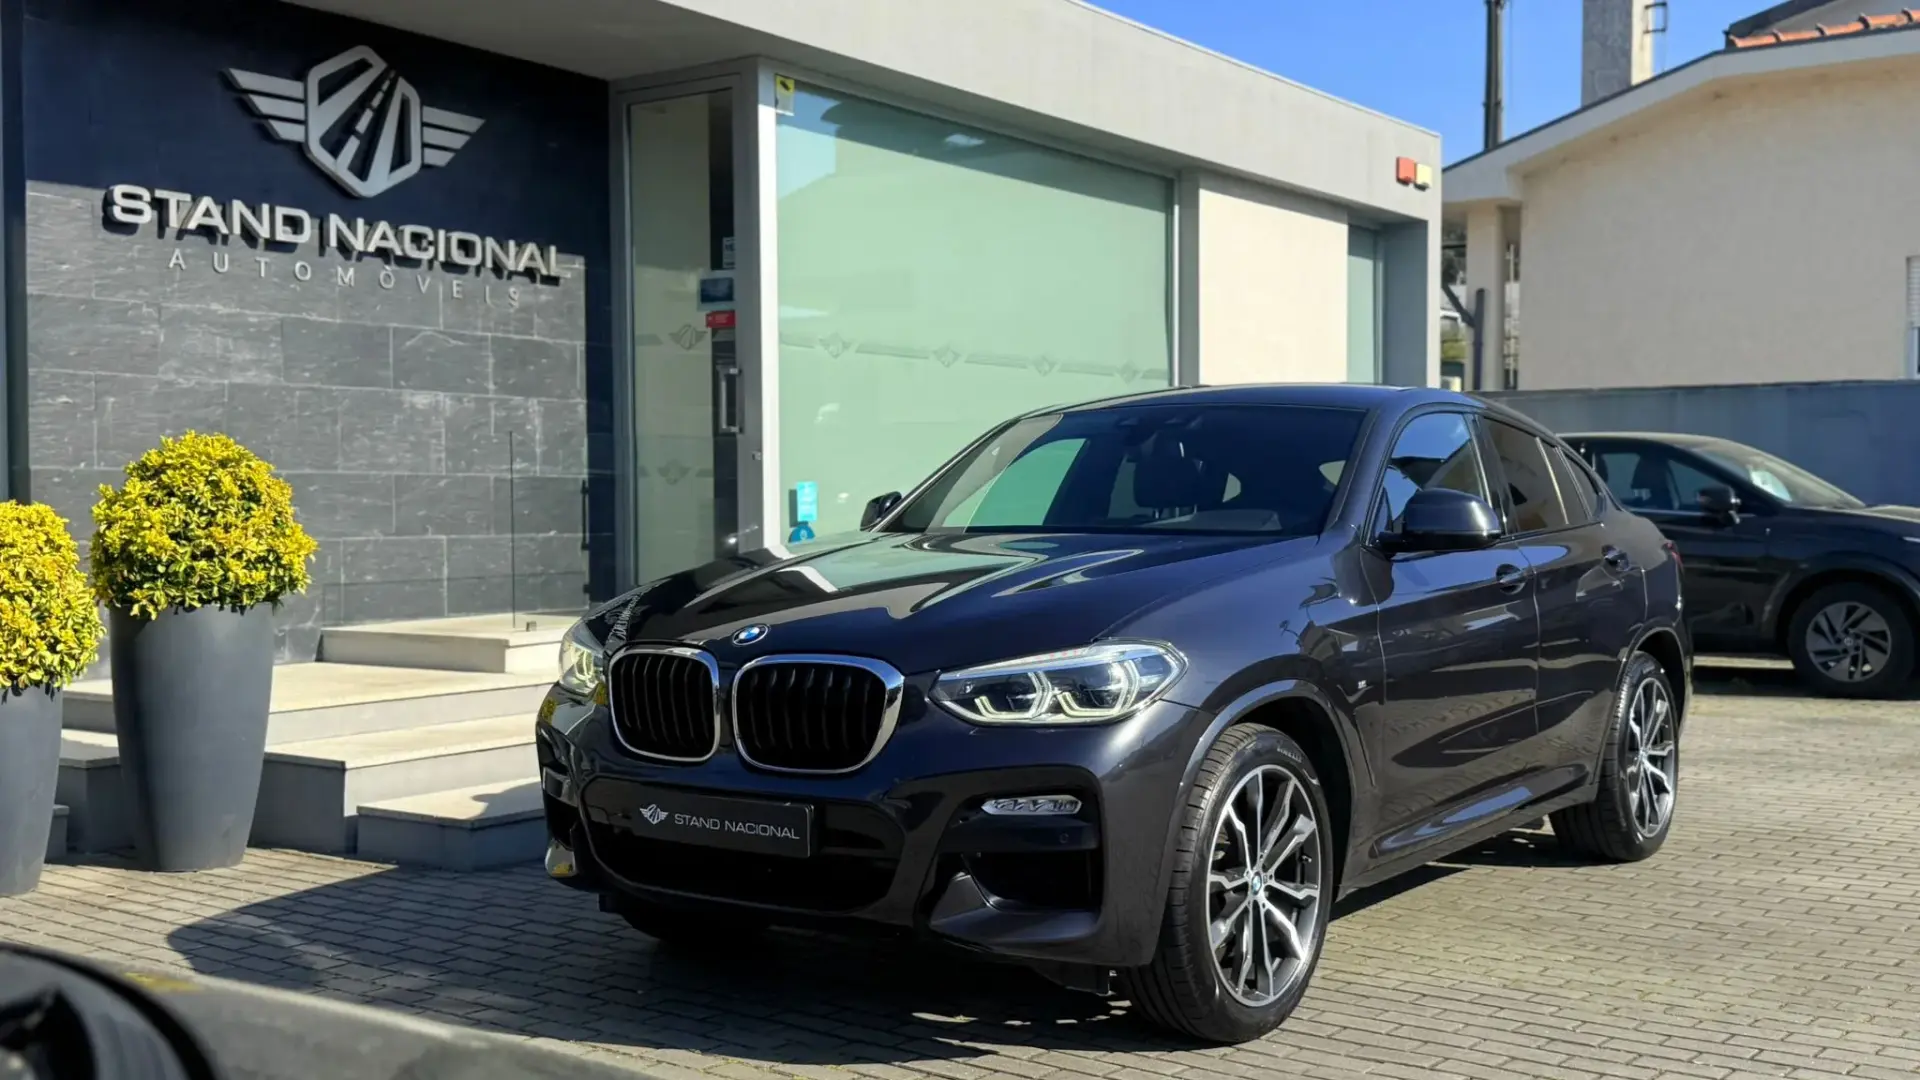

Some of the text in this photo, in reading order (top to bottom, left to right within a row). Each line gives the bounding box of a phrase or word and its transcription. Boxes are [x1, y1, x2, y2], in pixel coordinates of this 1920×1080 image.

[111, 184, 572, 279] STAND NACIONAL
[674, 813, 801, 839] STAND NACIONAL
